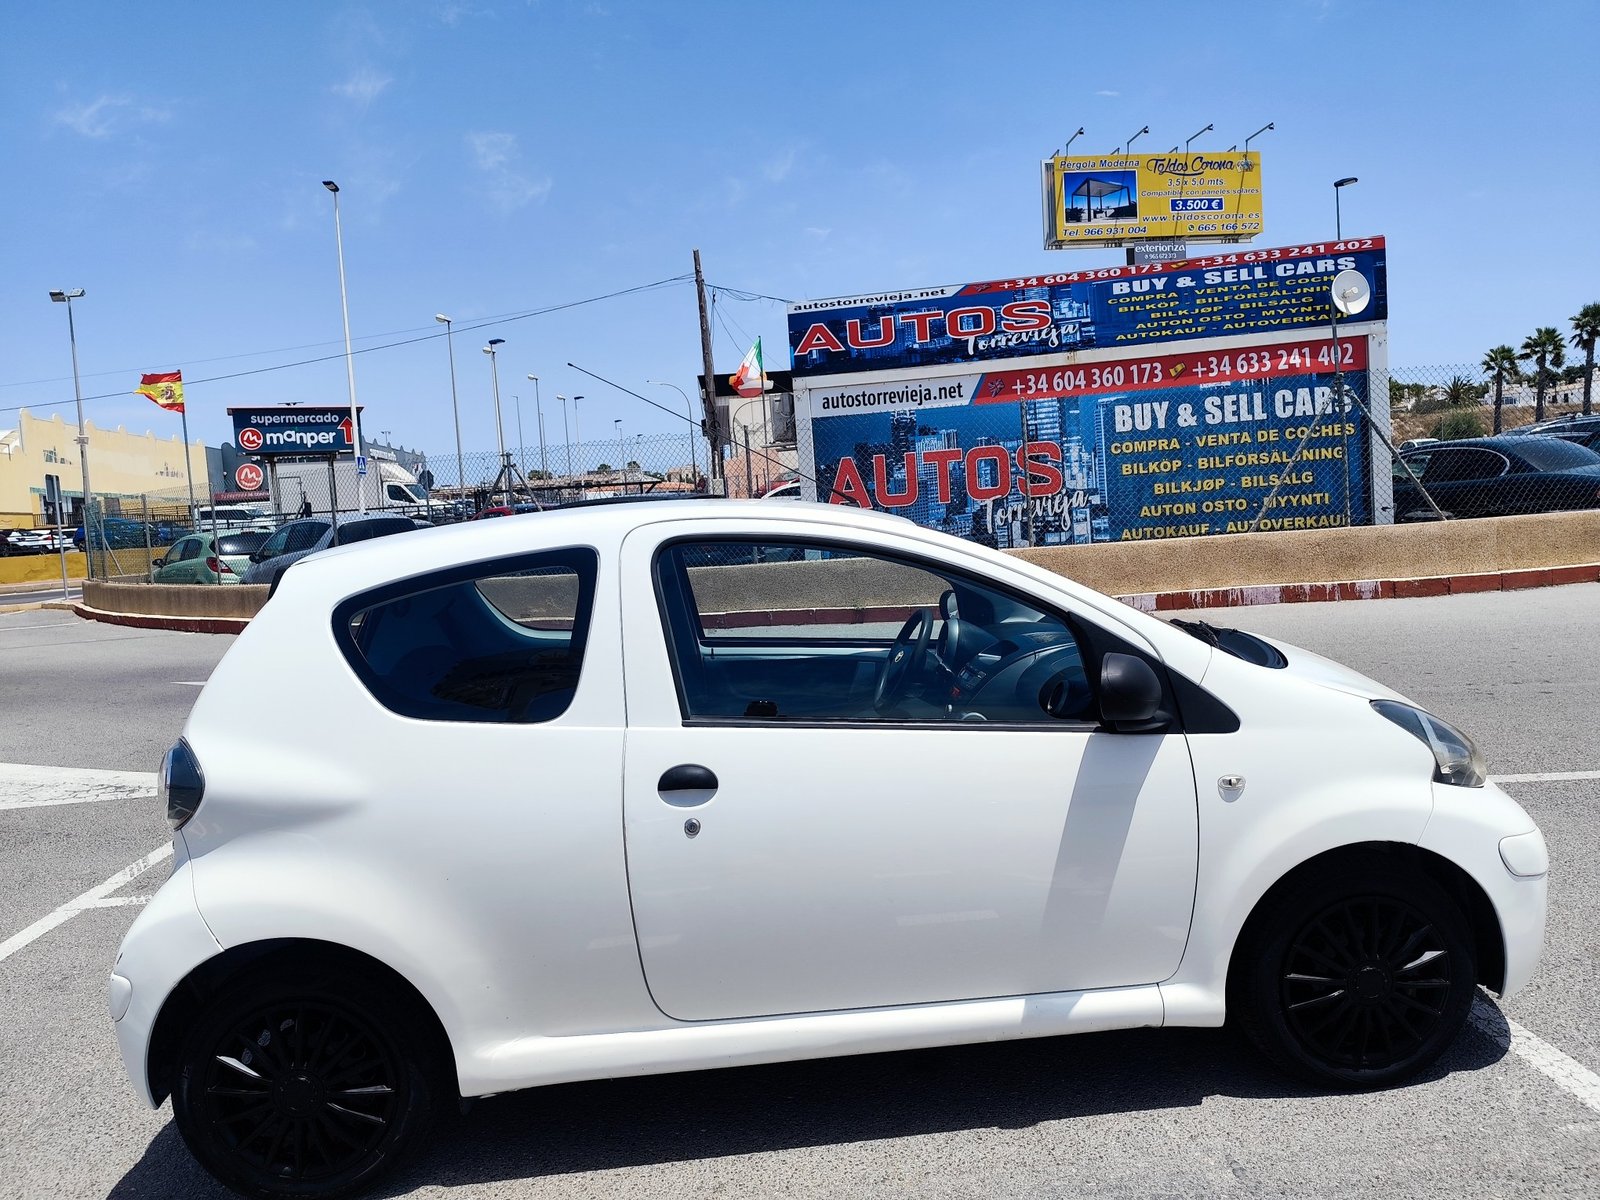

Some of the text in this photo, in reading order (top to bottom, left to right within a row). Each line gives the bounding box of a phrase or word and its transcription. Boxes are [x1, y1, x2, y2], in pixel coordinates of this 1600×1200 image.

[1099, 159, 1140, 168] Moderna
[1146, 156, 1235, 175] Toldos Corona
[1141, 189, 1183, 197] Compatible
[1201, 188, 1231, 196] paneles
[1232, 187, 1260, 195] solares
[1168, 178, 1181, 187] 3,5
[1191, 178, 1205, 186] 5,0
[1175, 199, 1220, 210] 3.500 €
[1142, 212, 1260, 222] www.toldoscorona.es
[1197, 222, 1260, 232] 665 166 572
[1062, 226, 1147, 237] Tel. 966 931 004
[1135, 242, 1186, 253] exterioriza
[1198, 239, 1374, 267] +34 633 241 402
[998, 263, 1163, 290] +34 604 360 173
[1112, 256, 1356, 295] BUY & SELL CARS
[793, 288, 947, 311] autostorrevieja.net
[1107, 291, 1178, 305] COMPRA
[1195, 284, 1250, 295] VENTA
[1257, 280, 1280, 289] DE
[1285, 275, 1335, 286] COCH
[1118, 301, 1179, 313] BILKÖP
[1196, 285, 1330, 305] BILFÖRSÄLJNIN
[1136, 318, 1193, 330] AUTON
[1199, 313, 1245, 323] OSTO
[1262, 304, 1330, 316] MYYNTI
[1150, 305, 1223, 319] BILKJØP
[1240, 296, 1313, 309] BILSALG
[794, 300, 1052, 356] AUTOS
[962, 322, 1079, 356] Torrevieja
[1116, 326, 1206, 340] AUTOKAUF
[1192, 343, 1354, 378] +34 633 241 402
[1011, 362, 1163, 395] +34 604 360 173
[822, 382, 963, 410] autostorrevieja.net
[1114, 384, 1353, 432] BUY & SELL CARS
[250, 412, 339, 426] supermercado
[266, 430, 336, 448] manper
[1110, 438, 1180, 454] COMPRA
[1196, 431, 1251, 447] VENTA
[1257, 429, 1279, 442] DE
[1285, 423, 1355, 440] COCHES
[829, 441, 1063, 510] AUTOS
[1122, 459, 1182, 475] BILKÖP
[1154, 479, 1225, 495] BILKJØP
[1241, 471, 1313, 488] BILSALG
[979, 488, 1091, 534] Torrevieja
[1140, 502, 1196, 518] AUTON
[1202, 498, 1247, 513] OSTO
[1263, 492, 1330, 508] MYYNTI
[1121, 523, 1210, 541] AUTOKAUF
